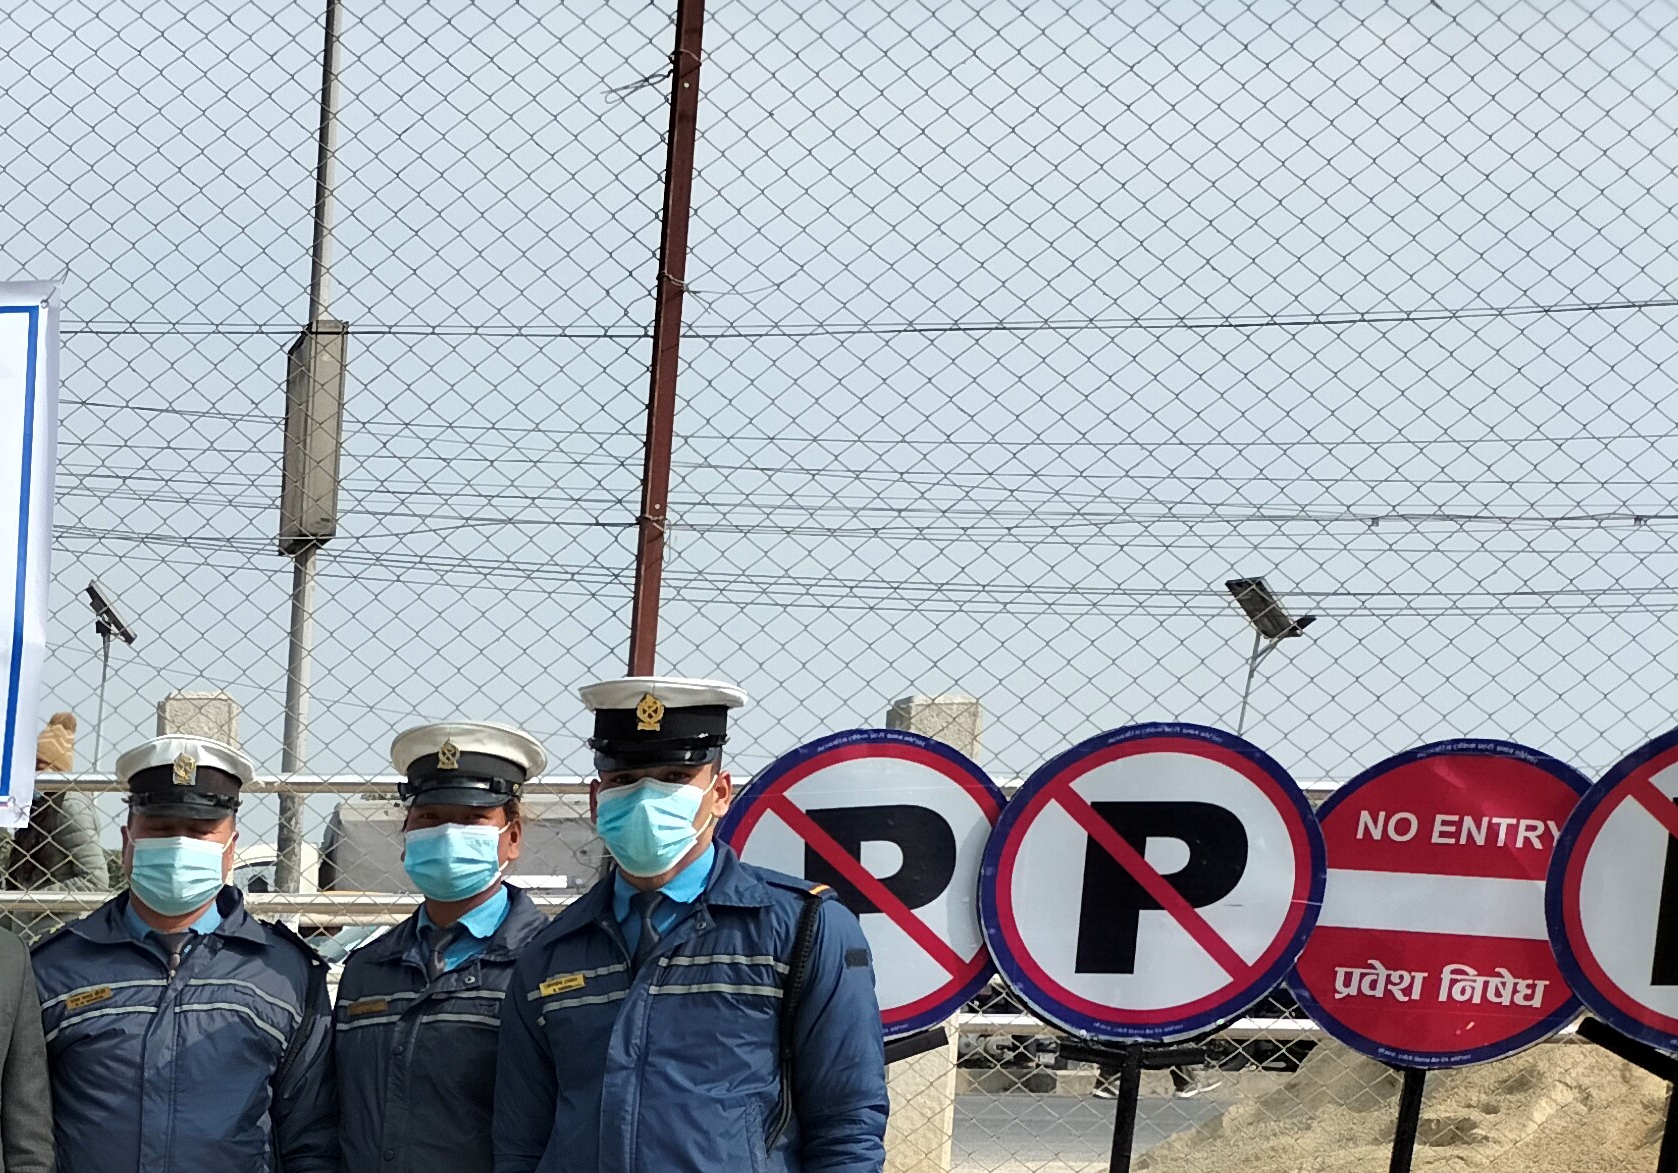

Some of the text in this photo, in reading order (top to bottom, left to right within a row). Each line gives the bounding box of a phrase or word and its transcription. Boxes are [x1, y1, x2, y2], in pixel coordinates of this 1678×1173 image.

[1356, 810, 1419, 842] NO
[1334, 960, 1550, 1008] प्रवेश निषेध
